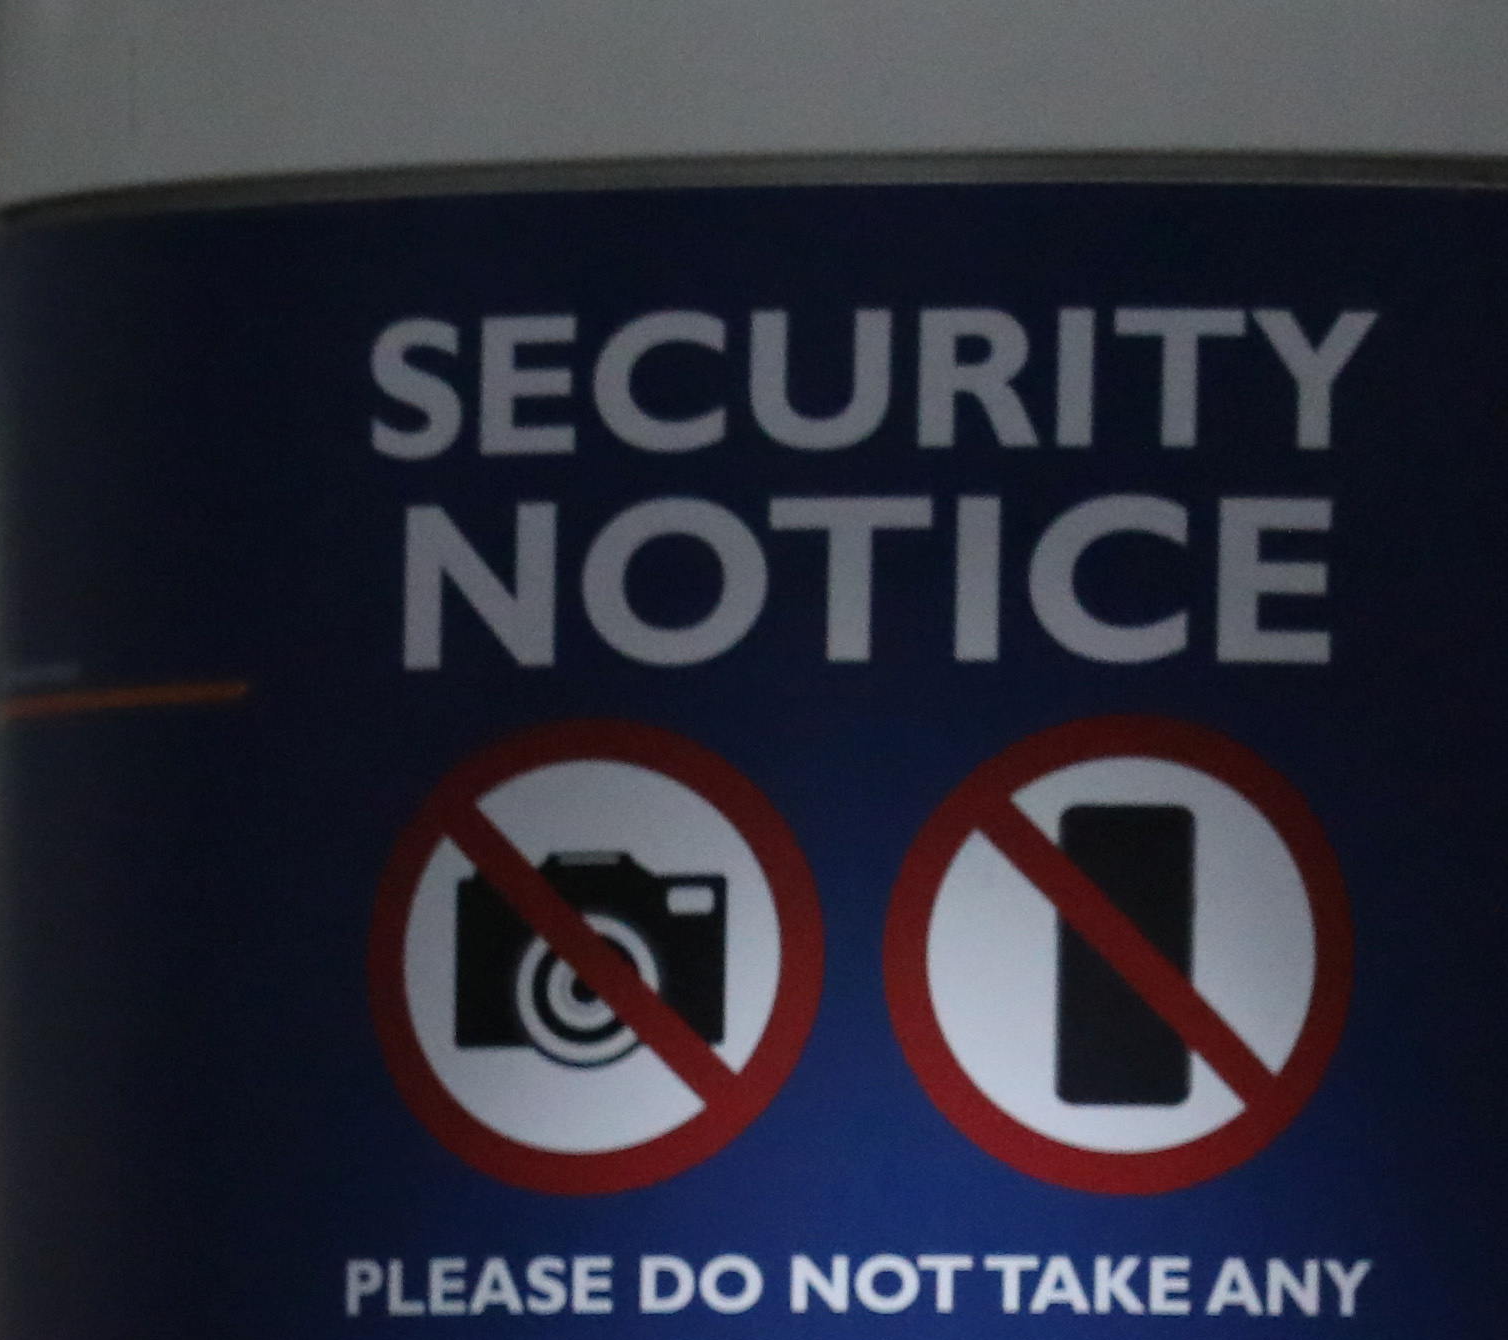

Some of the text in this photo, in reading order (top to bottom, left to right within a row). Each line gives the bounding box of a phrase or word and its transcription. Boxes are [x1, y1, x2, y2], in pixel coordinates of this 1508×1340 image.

[371, 306, 1377, 459] SECURITY
[403, 493, 1335, 671] NOTICE
[345, 1253, 1372, 1318] PLEASE DO NOT TAKE ANY
